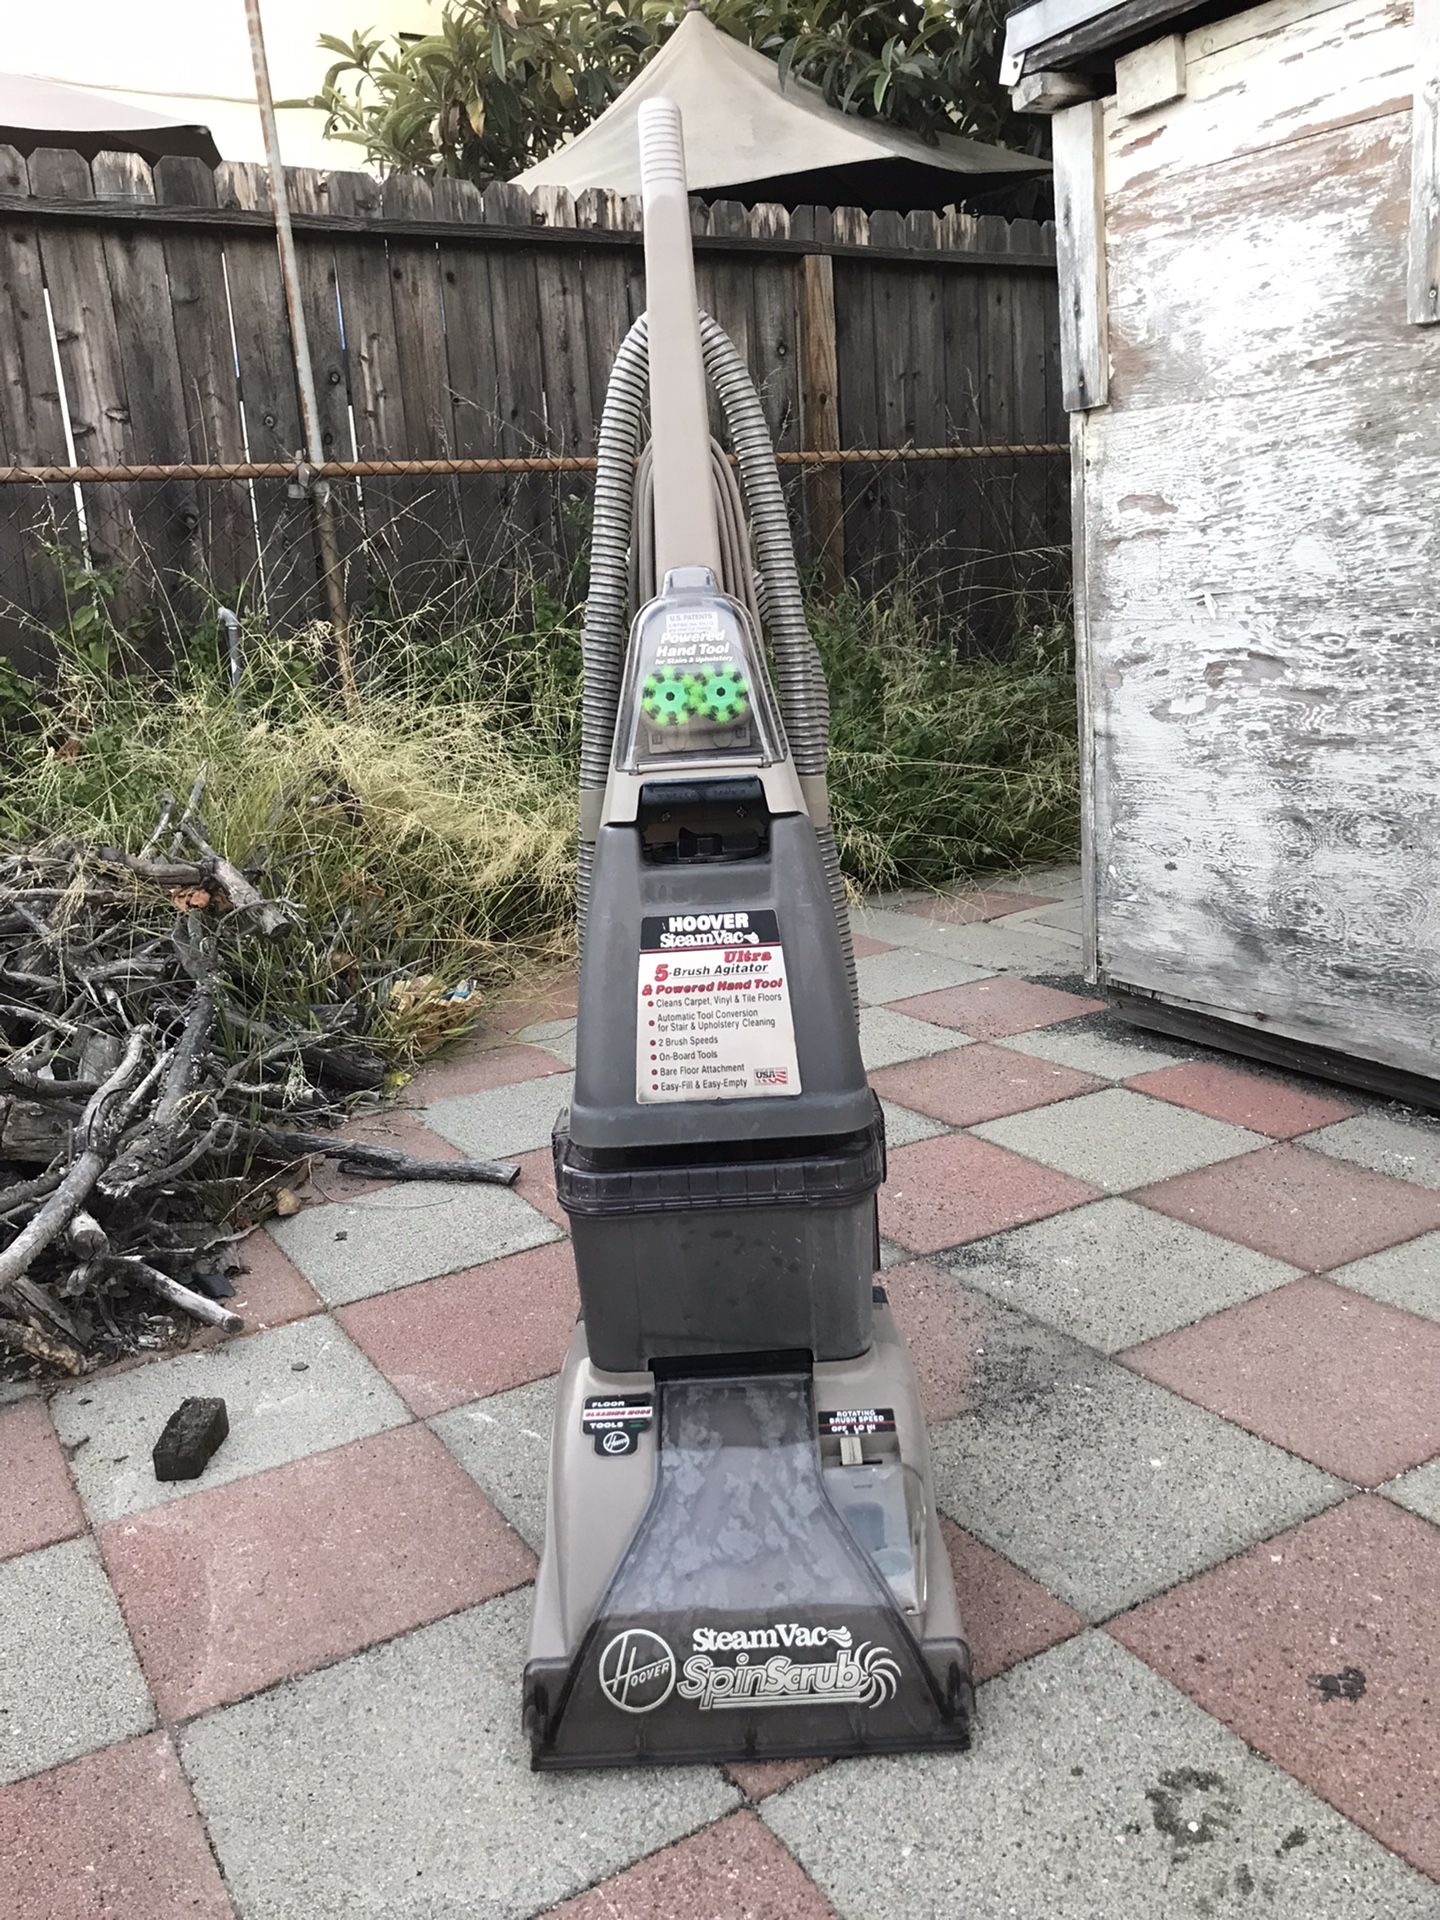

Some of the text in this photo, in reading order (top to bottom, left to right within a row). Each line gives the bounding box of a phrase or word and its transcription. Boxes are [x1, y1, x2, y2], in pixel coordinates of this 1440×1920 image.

[660, 629, 725, 644] Powered
[656, 642, 730, 657] Hand Tool
[695, 655, 733, 663] Upholstery
[669, 913, 749, 932] HOOVER
[660, 930, 744, 948] SteamVac
[724, 950, 772, 963] Ultra
[714, 963, 769, 976] Agitator
[641, 978, 783, 996] & Powered Hand Tool
[656, 993, 782, 1009] Cleans Carpet, Vinyl & Tile Floors
[657, 1009, 758, 1022] Automatic Tool Conversion
[657, 1017, 776, 1032] for Stair & Upholstery Cleaning
[658, 1036, 719, 1047] 2 Brush Speeds
[659, 1050, 718, 1061] On-Board Tools
[660, 1064, 745, 1076] Bare Floor Attachment
[660, 1078, 748, 1092] Easy-Fill & Easy-Empty
[829, 1415, 884, 1424] BRUSH SPEED
[693, 1623, 829, 1652] SteamVac
[677, 1650, 863, 1709] SpinScrub
